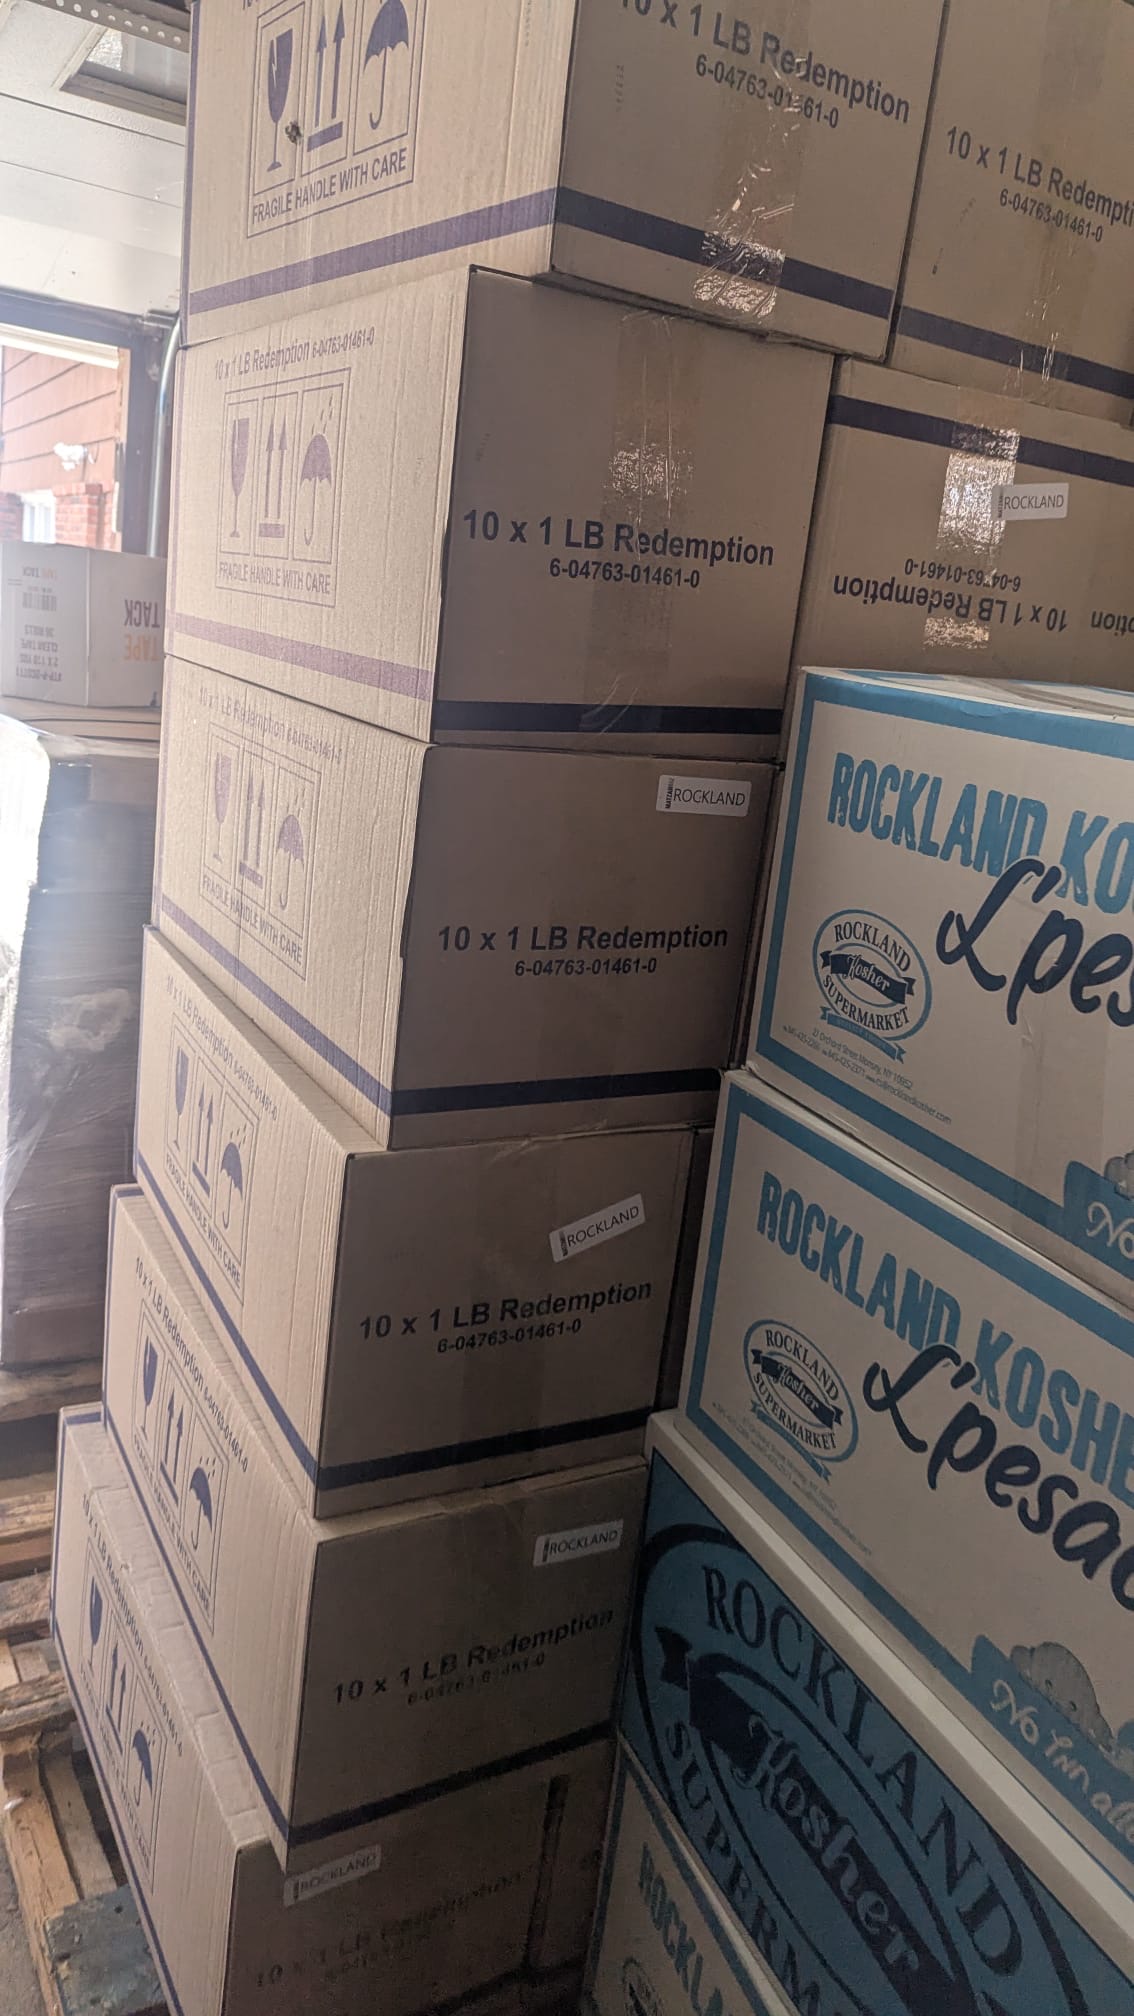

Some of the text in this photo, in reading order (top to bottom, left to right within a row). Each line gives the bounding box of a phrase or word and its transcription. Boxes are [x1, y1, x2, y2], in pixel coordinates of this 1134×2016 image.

[690, 3, 702, 37] 1
[713, 20, 750, 56] LB
[760, 34, 910, 124] Redemption
[947, 126, 971, 161] 10
[977, 144, 990, 169] x
[998, 147, 1009, 174] 1
[1014, 153, 1042, 188] LB
[252, 147, 407, 225] FRAGILE HANDLE WITH CARE
[1000, 188, 1103, 243] 6-04763-01461-0
[250, 340, 310, 372] Redemption
[1003, 494, 1065, 511] ROCKLAND
[463, 509, 775, 566] 10 x 1 LB Redemption
[219, 561, 331, 595] FRAGILE HANDLE WITH CARE
[550, 558, 700, 588] 6-04763-01461-0
[124, 599, 160, 629] TACK
[833, 575, 1068, 632] 10 x 1 LB Redemption
[123, 634, 160, 663] TAPE
[673, 787, 746, 807] ROCKLAND
[827, 752, 1048, 878] ROCKLAND
[280, 934, 302, 966] CARE
[439, 925, 728, 954] 10 x 1 LB Redemption
[515, 958, 657, 977] 6-04763-01461-0
[834, 921, 911, 973] ROCKLAND
[846, 953, 891, 993] Kosher
[822, 974, 910, 1031] SUPERMARKET
[192, 1006, 233, 1068] Redemption
[568, 1205, 639, 1247] ROCKLAND
[208, 1221, 223, 1258] WITH
[223, 1251, 241, 1290] CARE
[757, 1171, 961, 1352] ROCKLAND
[359, 1281, 651, 1339] 10 x 1 LB Redemption
[437, 1318, 582, 1353] 6-04763-01461-0
[162, 1309, 204, 1392] Redemption
[764, 1329, 839, 1401] ROCKLAND
[753, 1370, 838, 1451] SUPERMARKET
[777, 1362, 821, 1413] Kosher
[549, 1529, 619, 1555] ROCKLAND
[106, 1555, 144, 1657] Redemption
[334, 1678, 363, 1703] 10
[374, 1678, 386, 1693] x
[400, 1666, 411, 1687] 1
[467, 1608, 614, 1668] Redemption
[988, 1678, 1039, 1746] No
[702, 1563, 1024, 1979] ROCKLAND
[731, 1713, 920, 1974] Kosher
[299, 1854, 377, 1891] ROCKLAND
